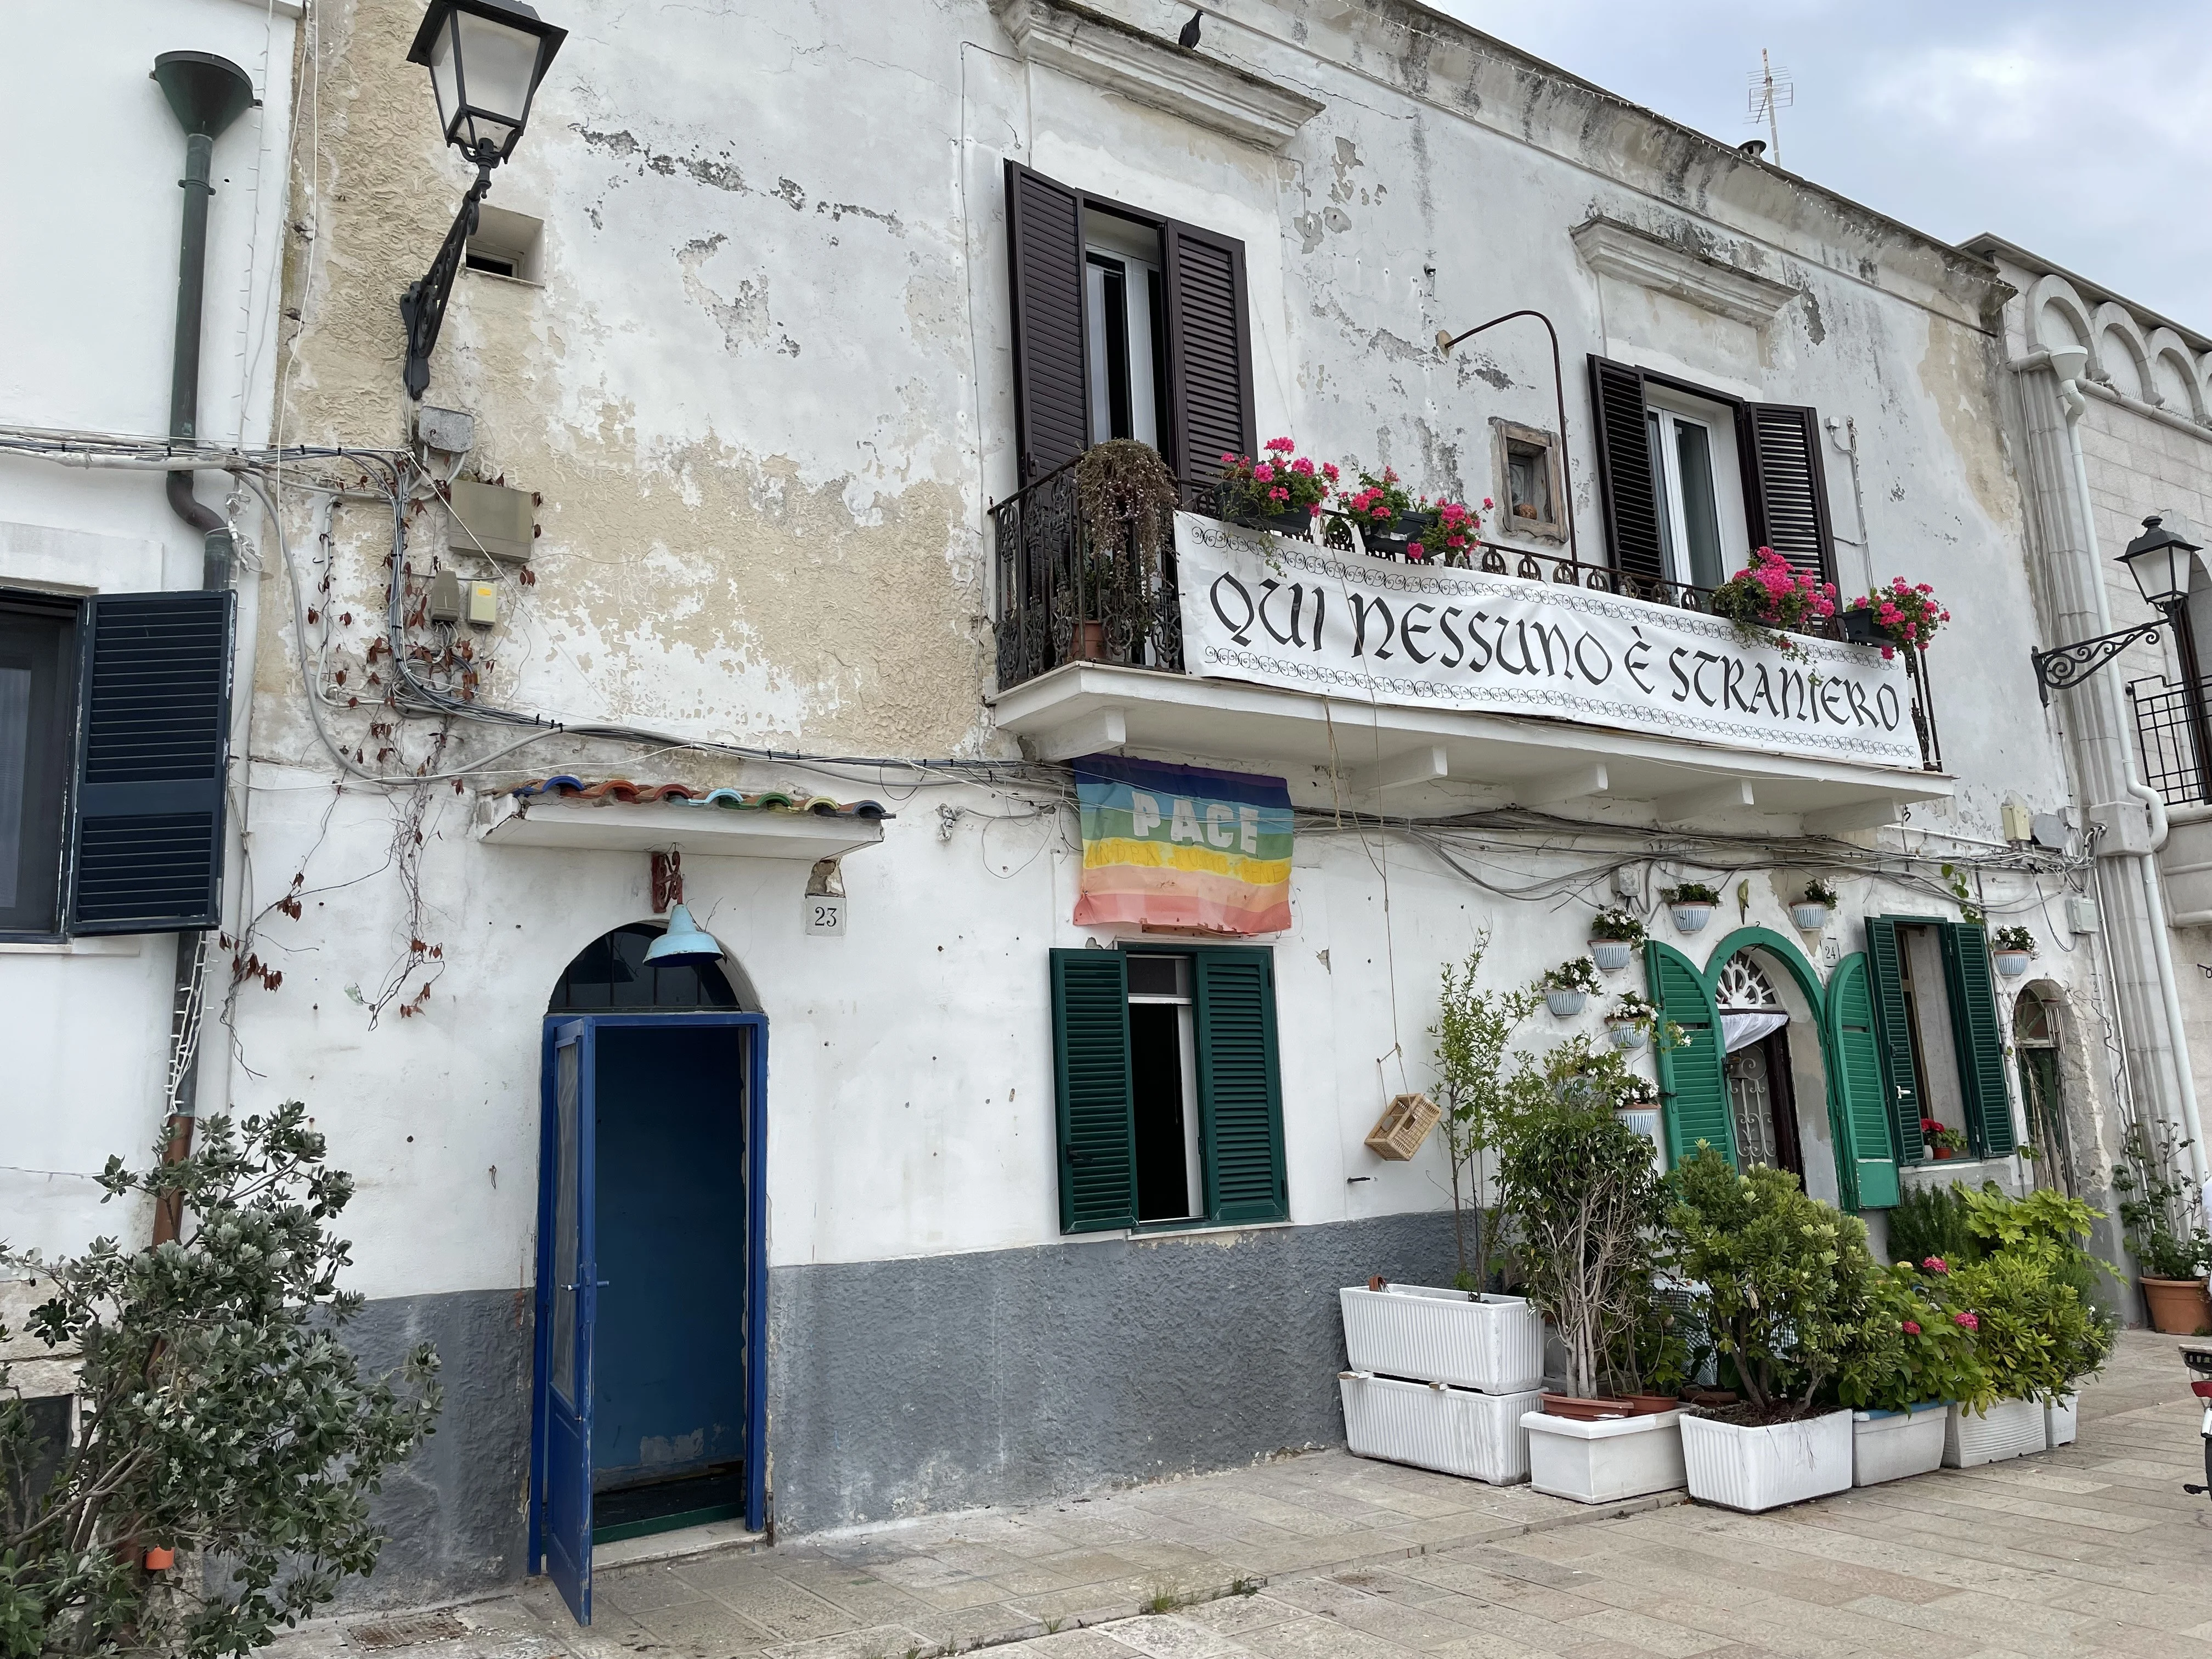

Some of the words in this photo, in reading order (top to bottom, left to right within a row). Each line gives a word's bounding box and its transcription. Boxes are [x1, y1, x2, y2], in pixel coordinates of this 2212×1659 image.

[1210, 571, 1325, 652] QUI
[1348, 592, 1613, 686] NESSUNO
[1624, 625, 1655, 695] È
[1669, 646, 1900, 732] STRANIERO
[1131, 791, 1260, 854] PACE
[814, 906, 837, 927] 23
[1824, 946, 1836, 960] 24
